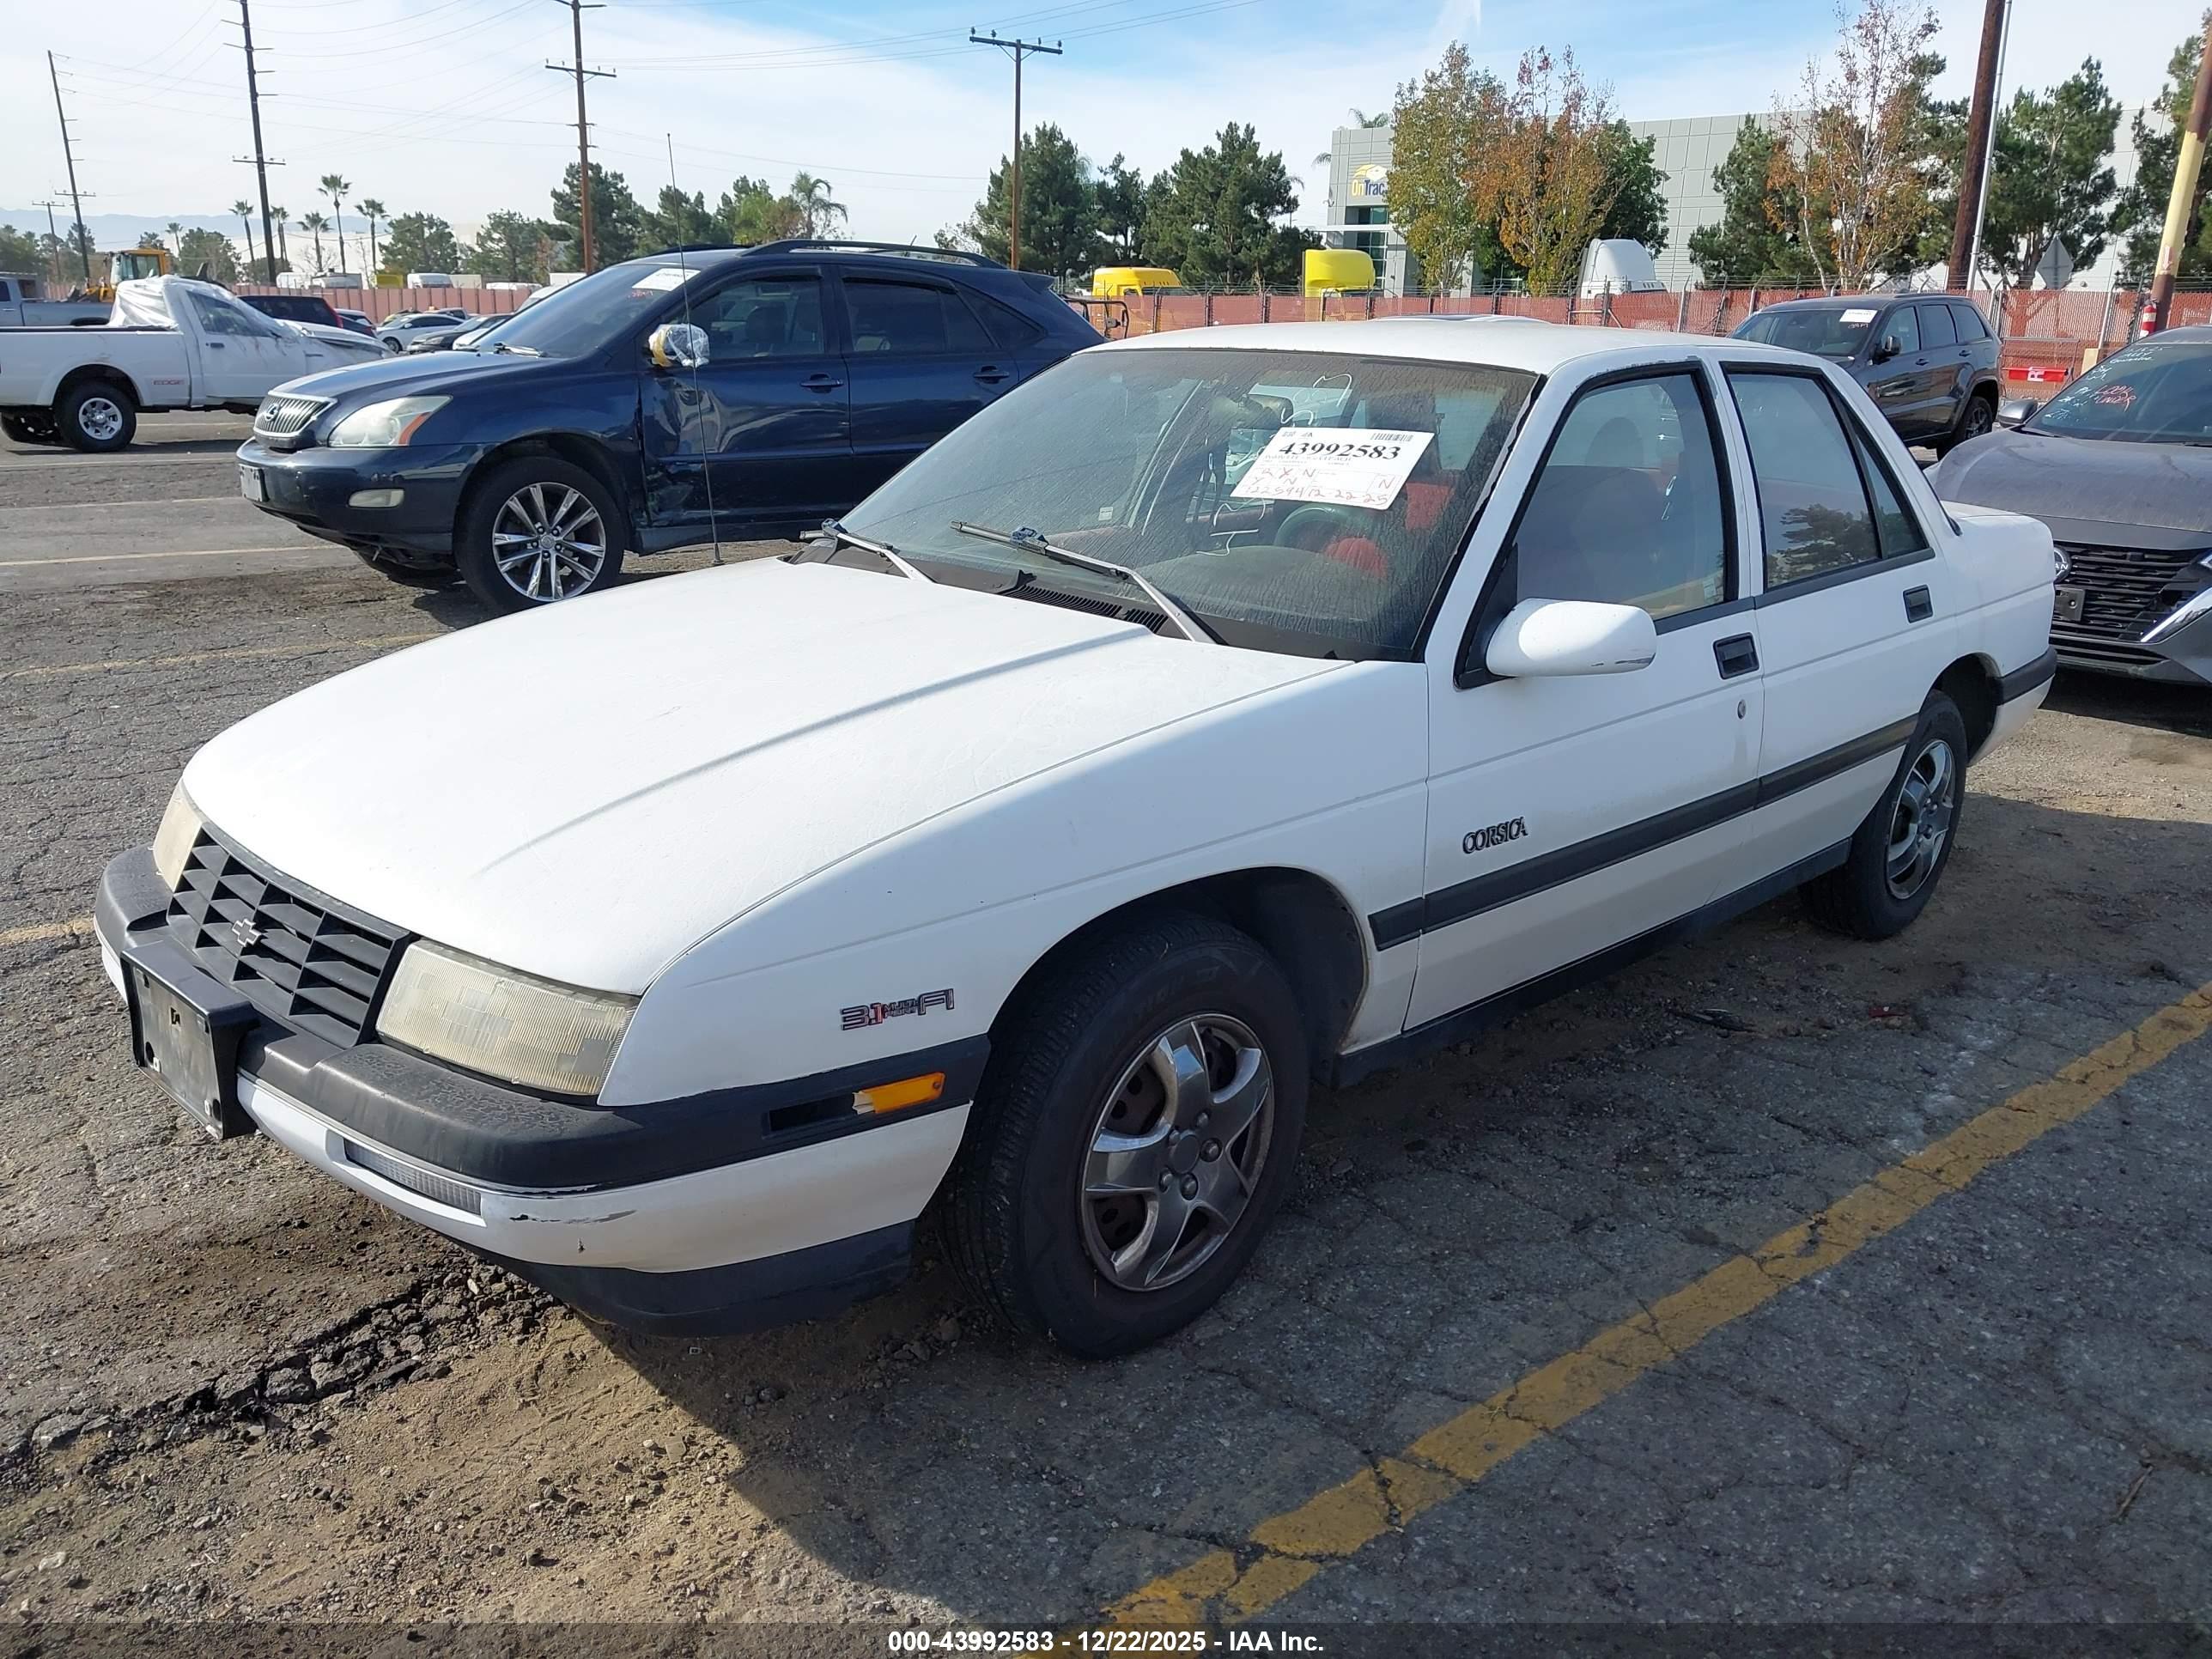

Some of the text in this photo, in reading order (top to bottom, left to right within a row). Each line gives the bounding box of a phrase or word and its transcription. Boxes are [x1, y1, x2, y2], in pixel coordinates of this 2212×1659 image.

[1352, 179, 1385, 197] OnTrac
[1279, 441, 1401, 460] 43992583
[1462, 817, 1528, 854] CORSICA
